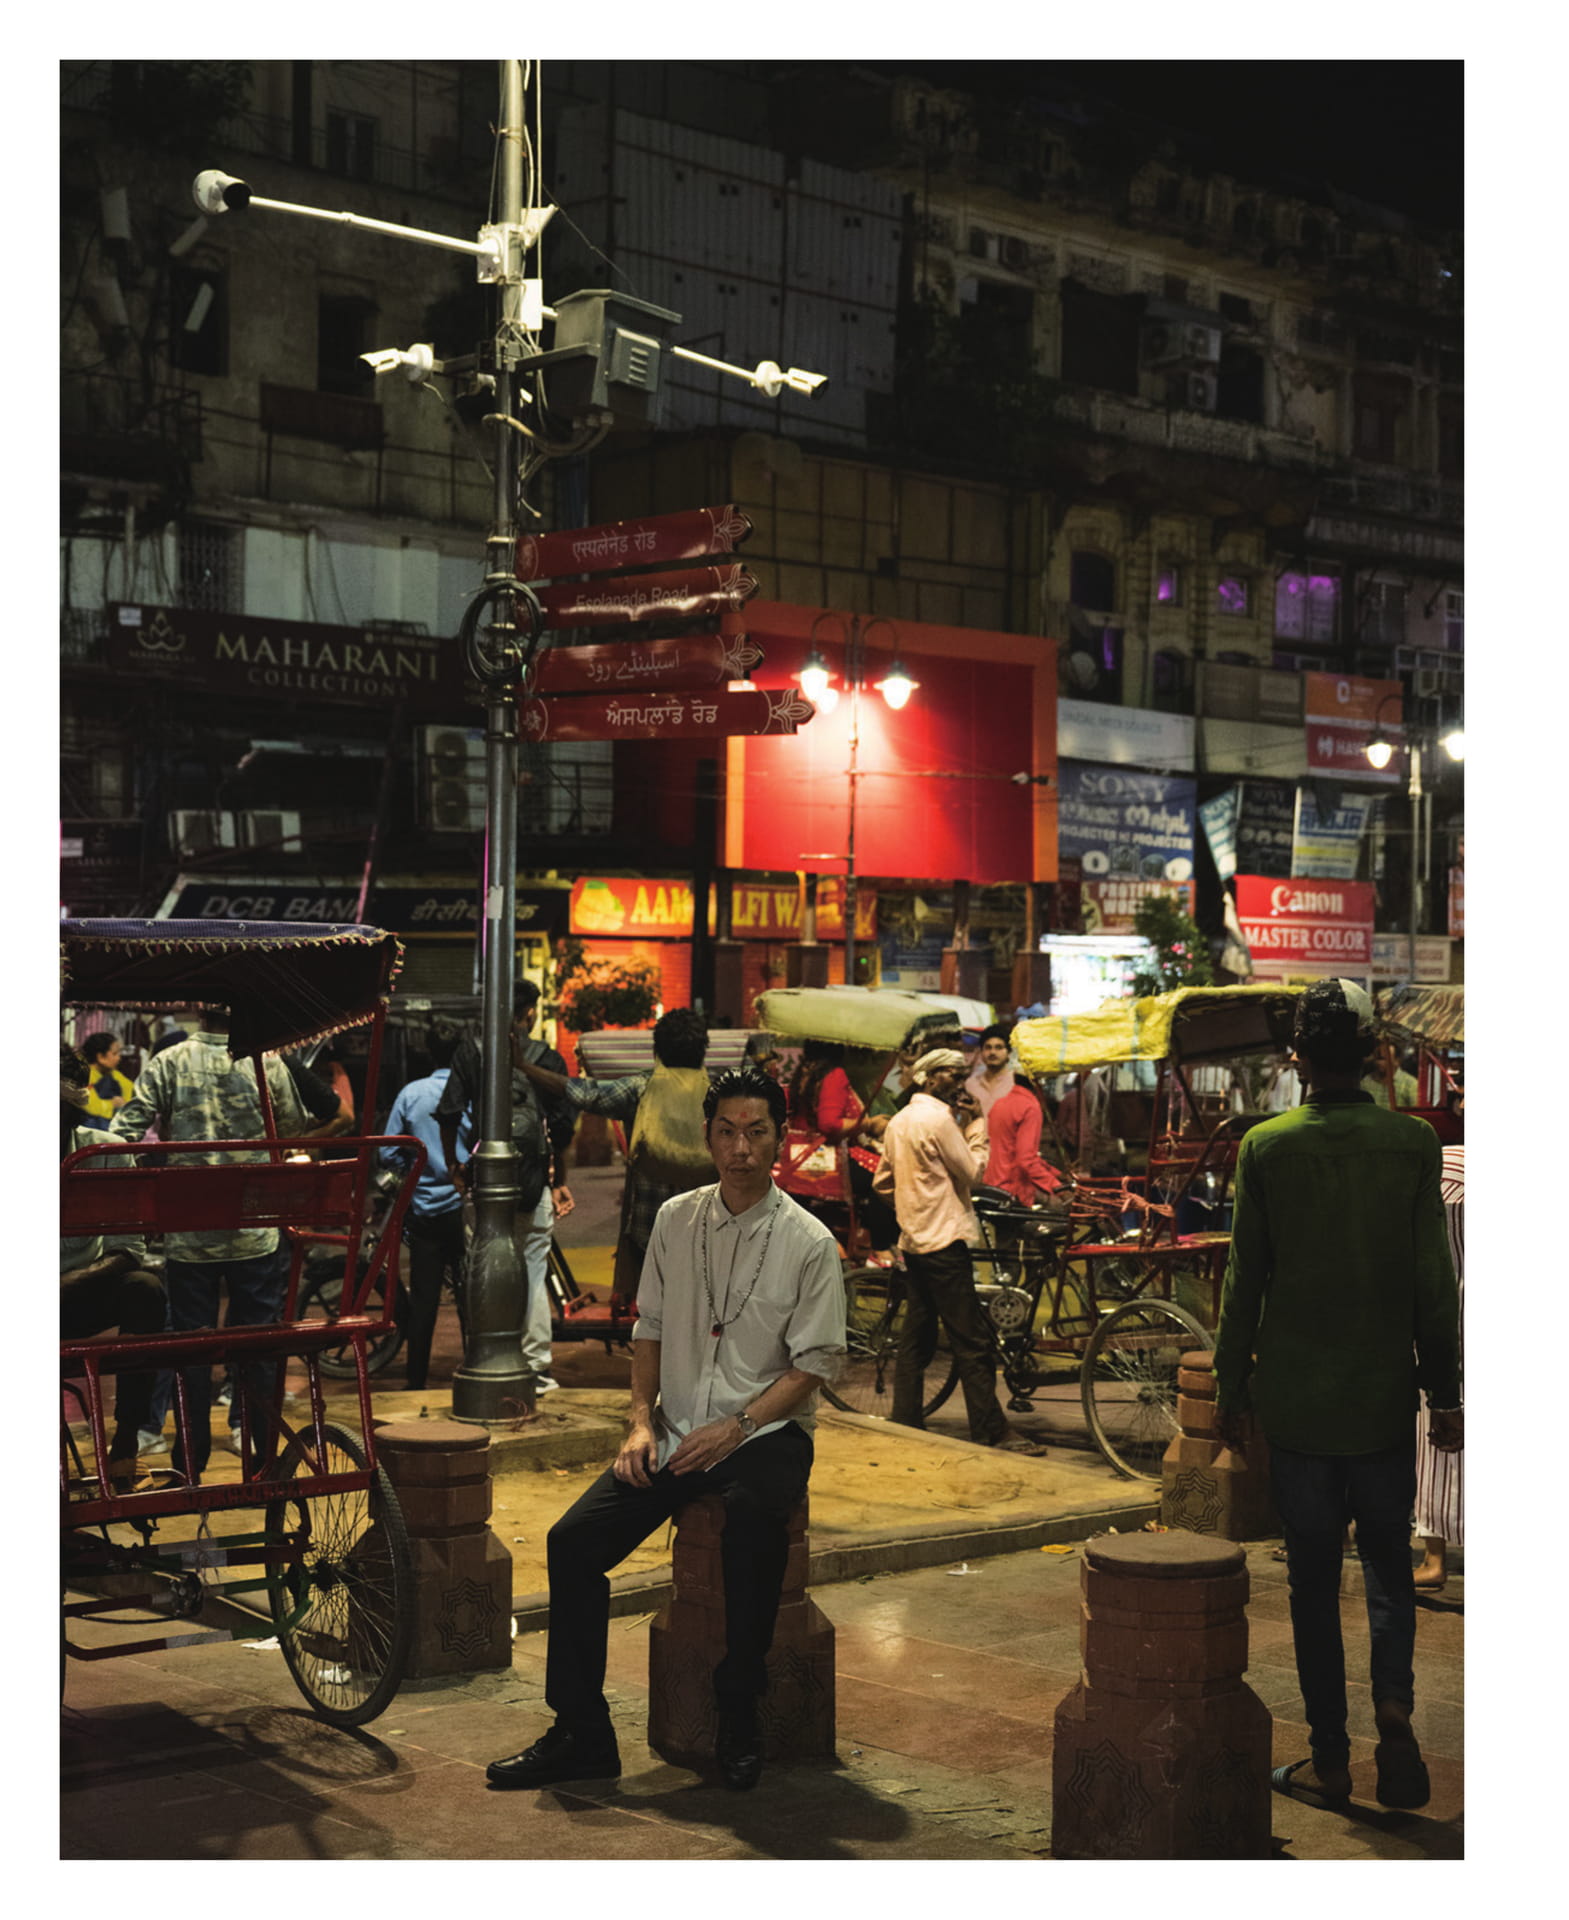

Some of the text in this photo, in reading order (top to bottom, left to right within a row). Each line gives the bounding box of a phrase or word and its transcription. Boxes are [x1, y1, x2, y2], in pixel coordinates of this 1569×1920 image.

[633, 527, 657, 552] रोड
[576, 583, 689, 611] Esplanade Road
[215, 631, 438, 682] MAHARANI
[247, 668, 409, 698] COLLECTIONS
[690, 698, 719, 724] ਰੋਡ
[1080, 772, 1170, 803] SONY
[200, 895, 276, 918] DCB
[630, 886, 697, 925] AAM
[1270, 885, 1344, 916] Canon
[1244, 926, 1312, 951] MASTER
[1313, 928, 1367, 952] COLOR
